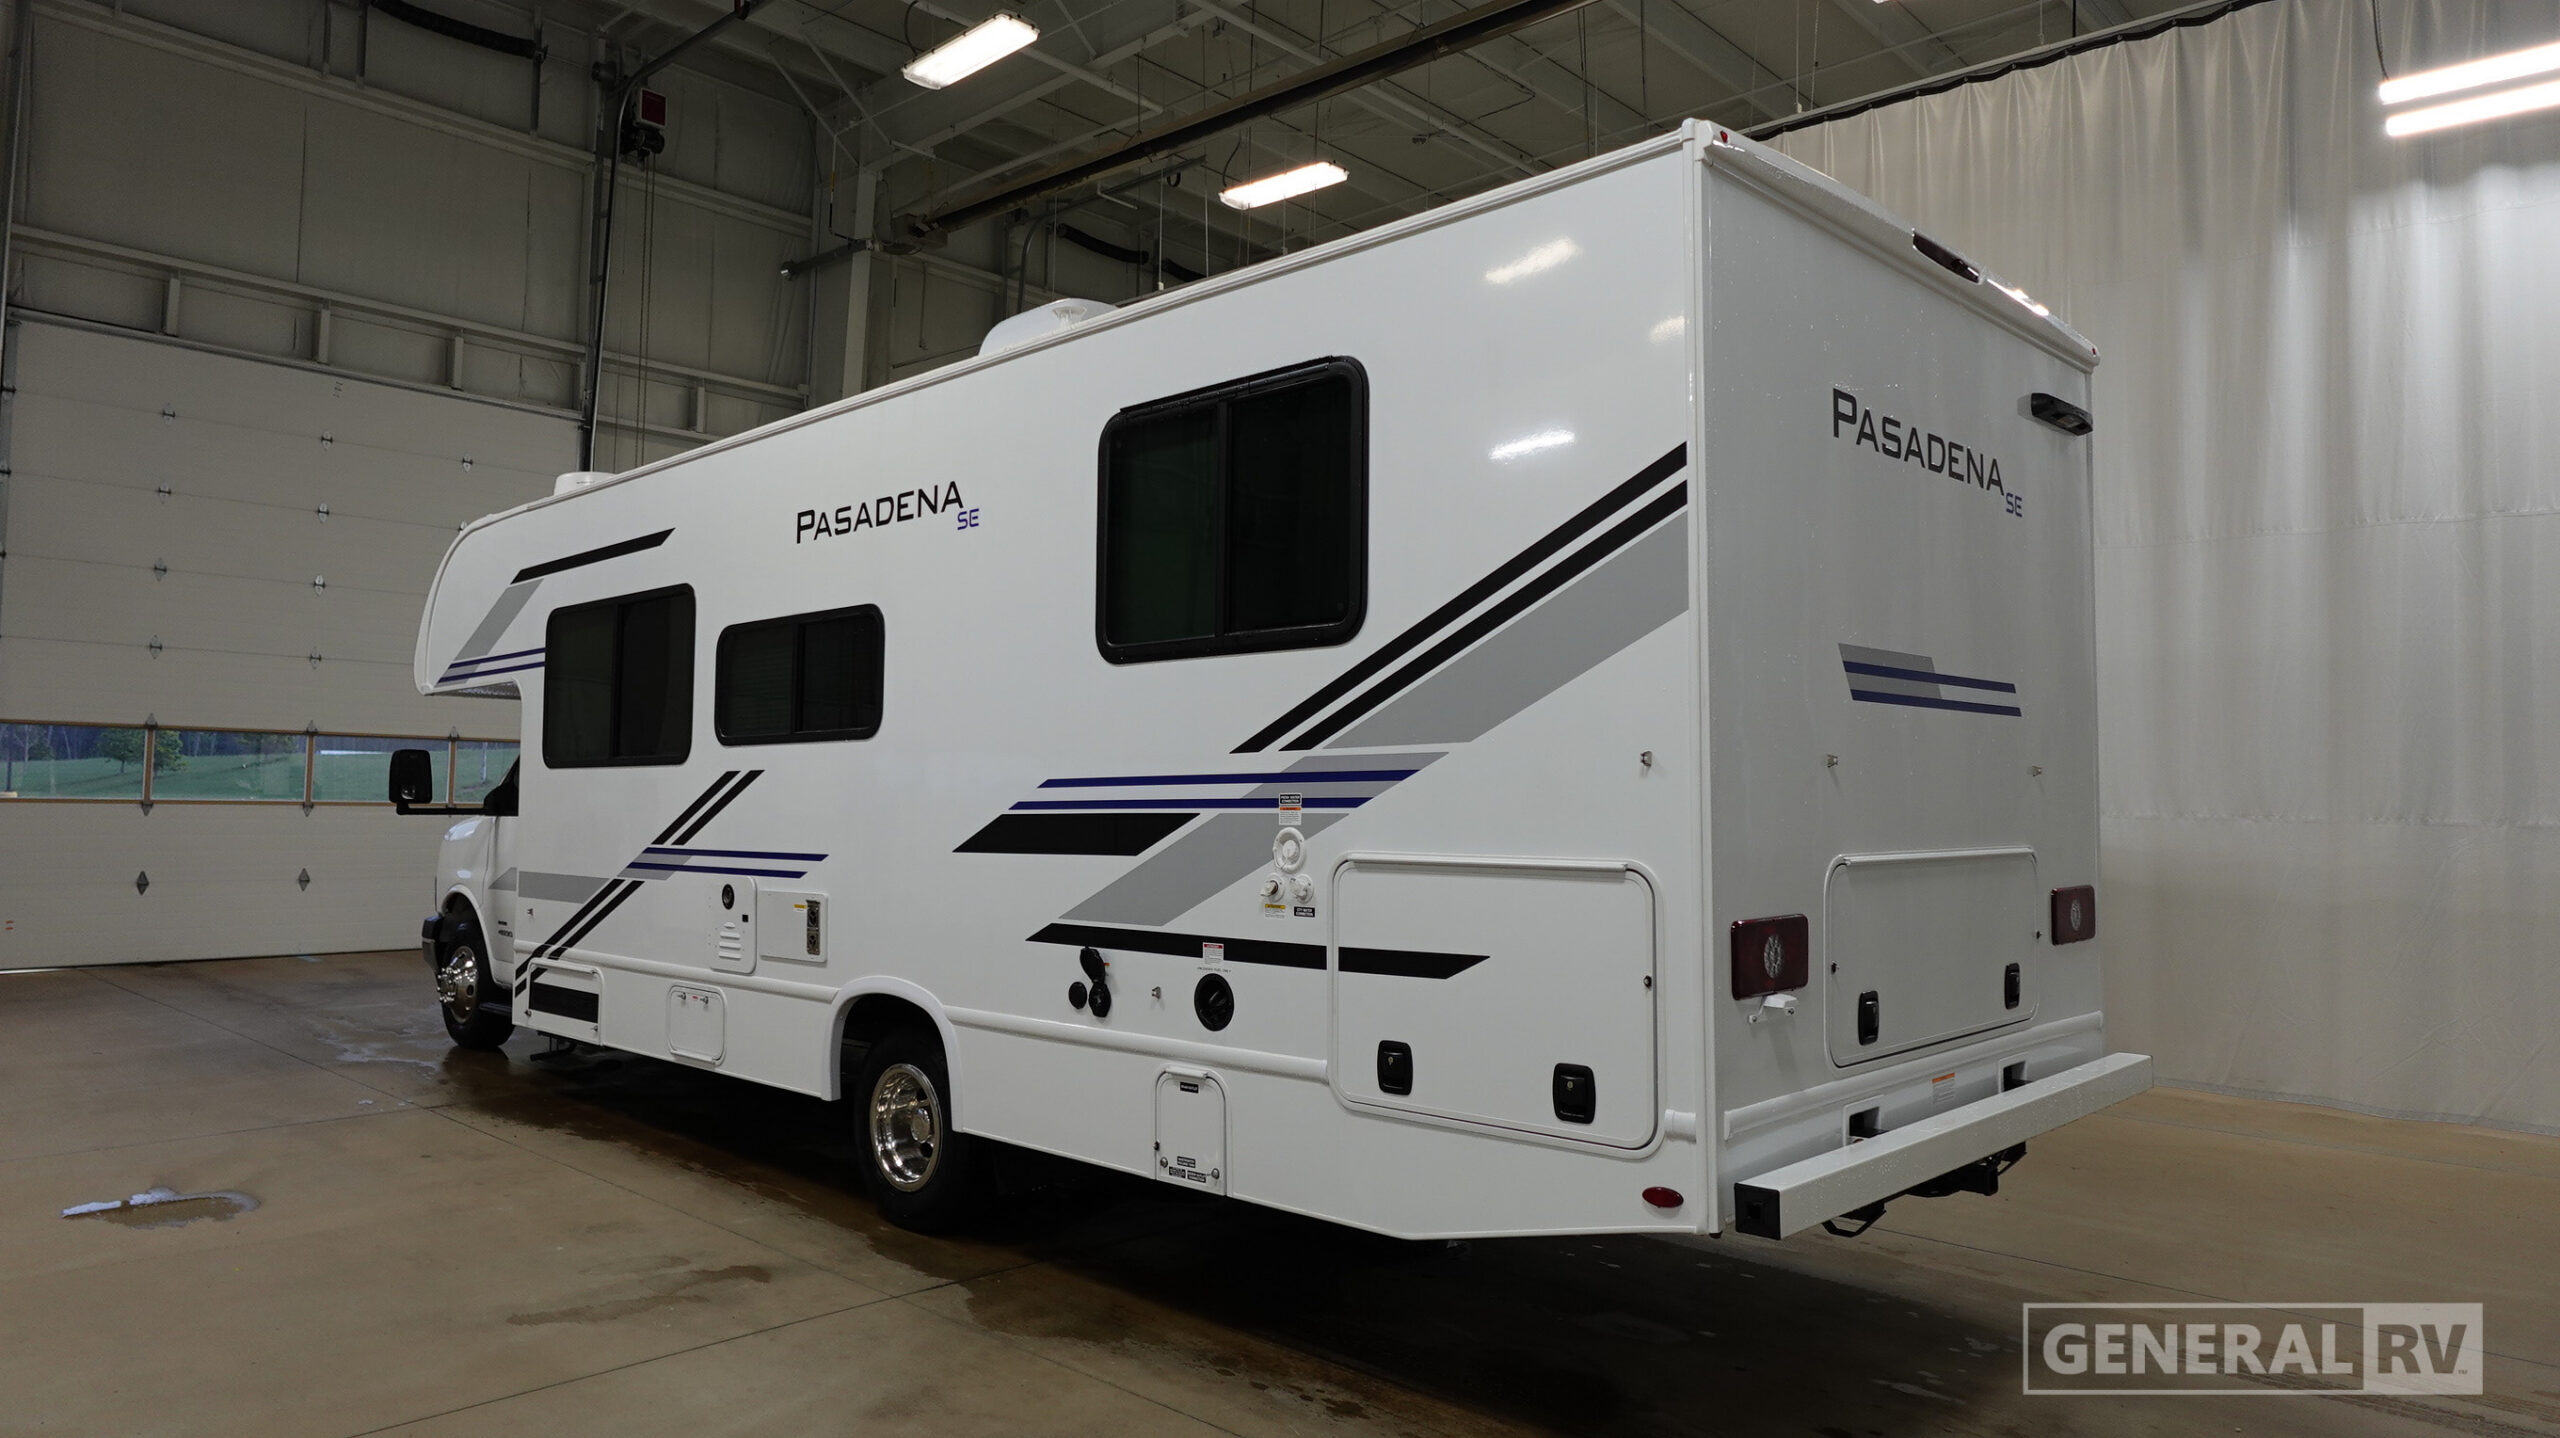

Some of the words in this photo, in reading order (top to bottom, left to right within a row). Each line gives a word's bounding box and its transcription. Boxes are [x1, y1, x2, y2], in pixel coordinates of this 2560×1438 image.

[1832, 387, 2005, 496] PASADENA
[2005, 492, 2023, 518] SE
[796, 481, 964, 544] PASADENA
[957, 508, 980, 531] SE
